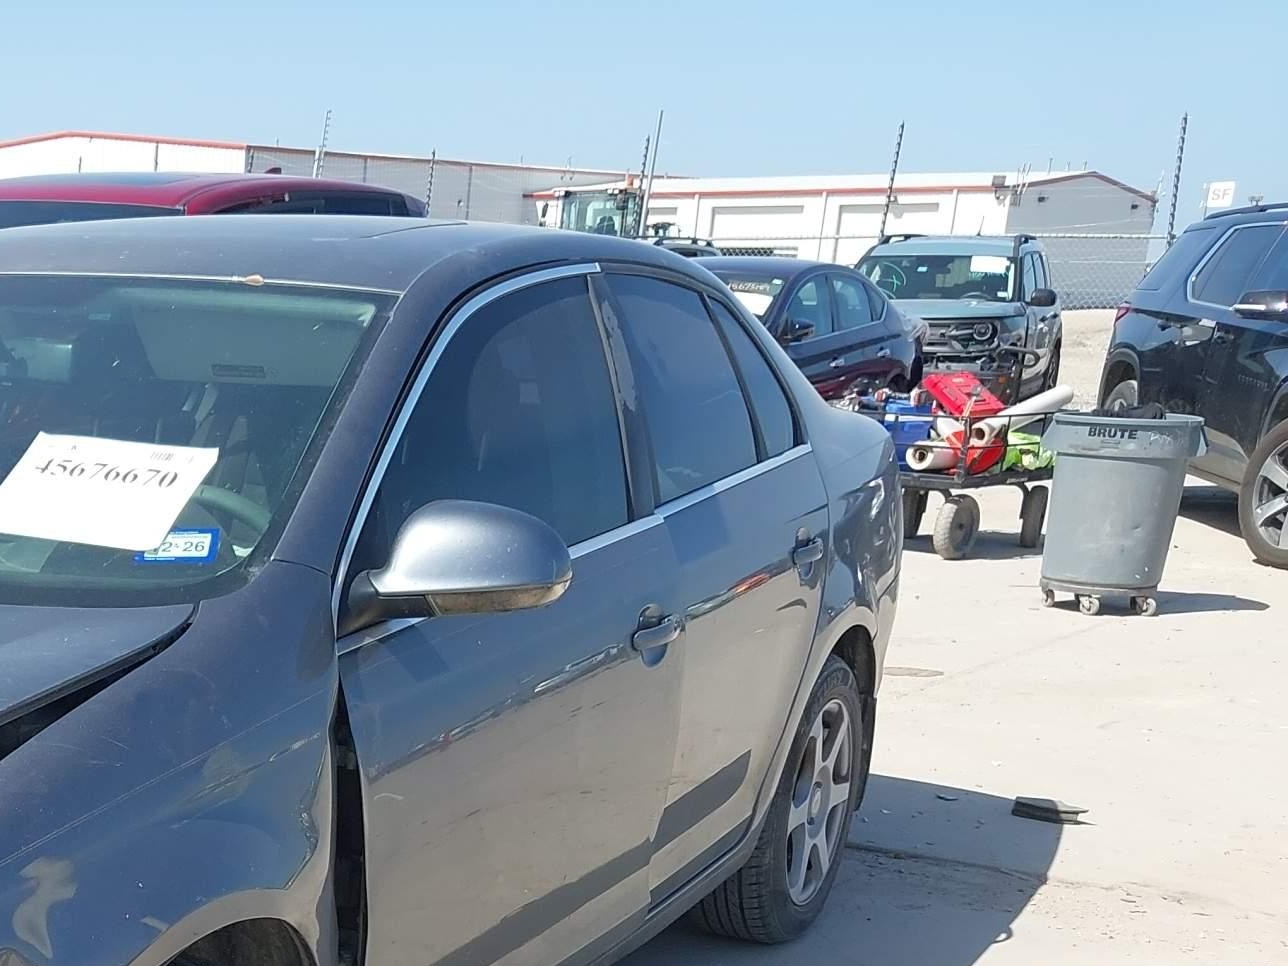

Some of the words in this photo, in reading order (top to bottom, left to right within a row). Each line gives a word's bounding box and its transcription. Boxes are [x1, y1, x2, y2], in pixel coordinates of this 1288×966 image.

[1211, 188, 1232, 201] SF
[1087, 426, 1138, 440] BRUTE
[35, 457, 178, 488] 45676670
